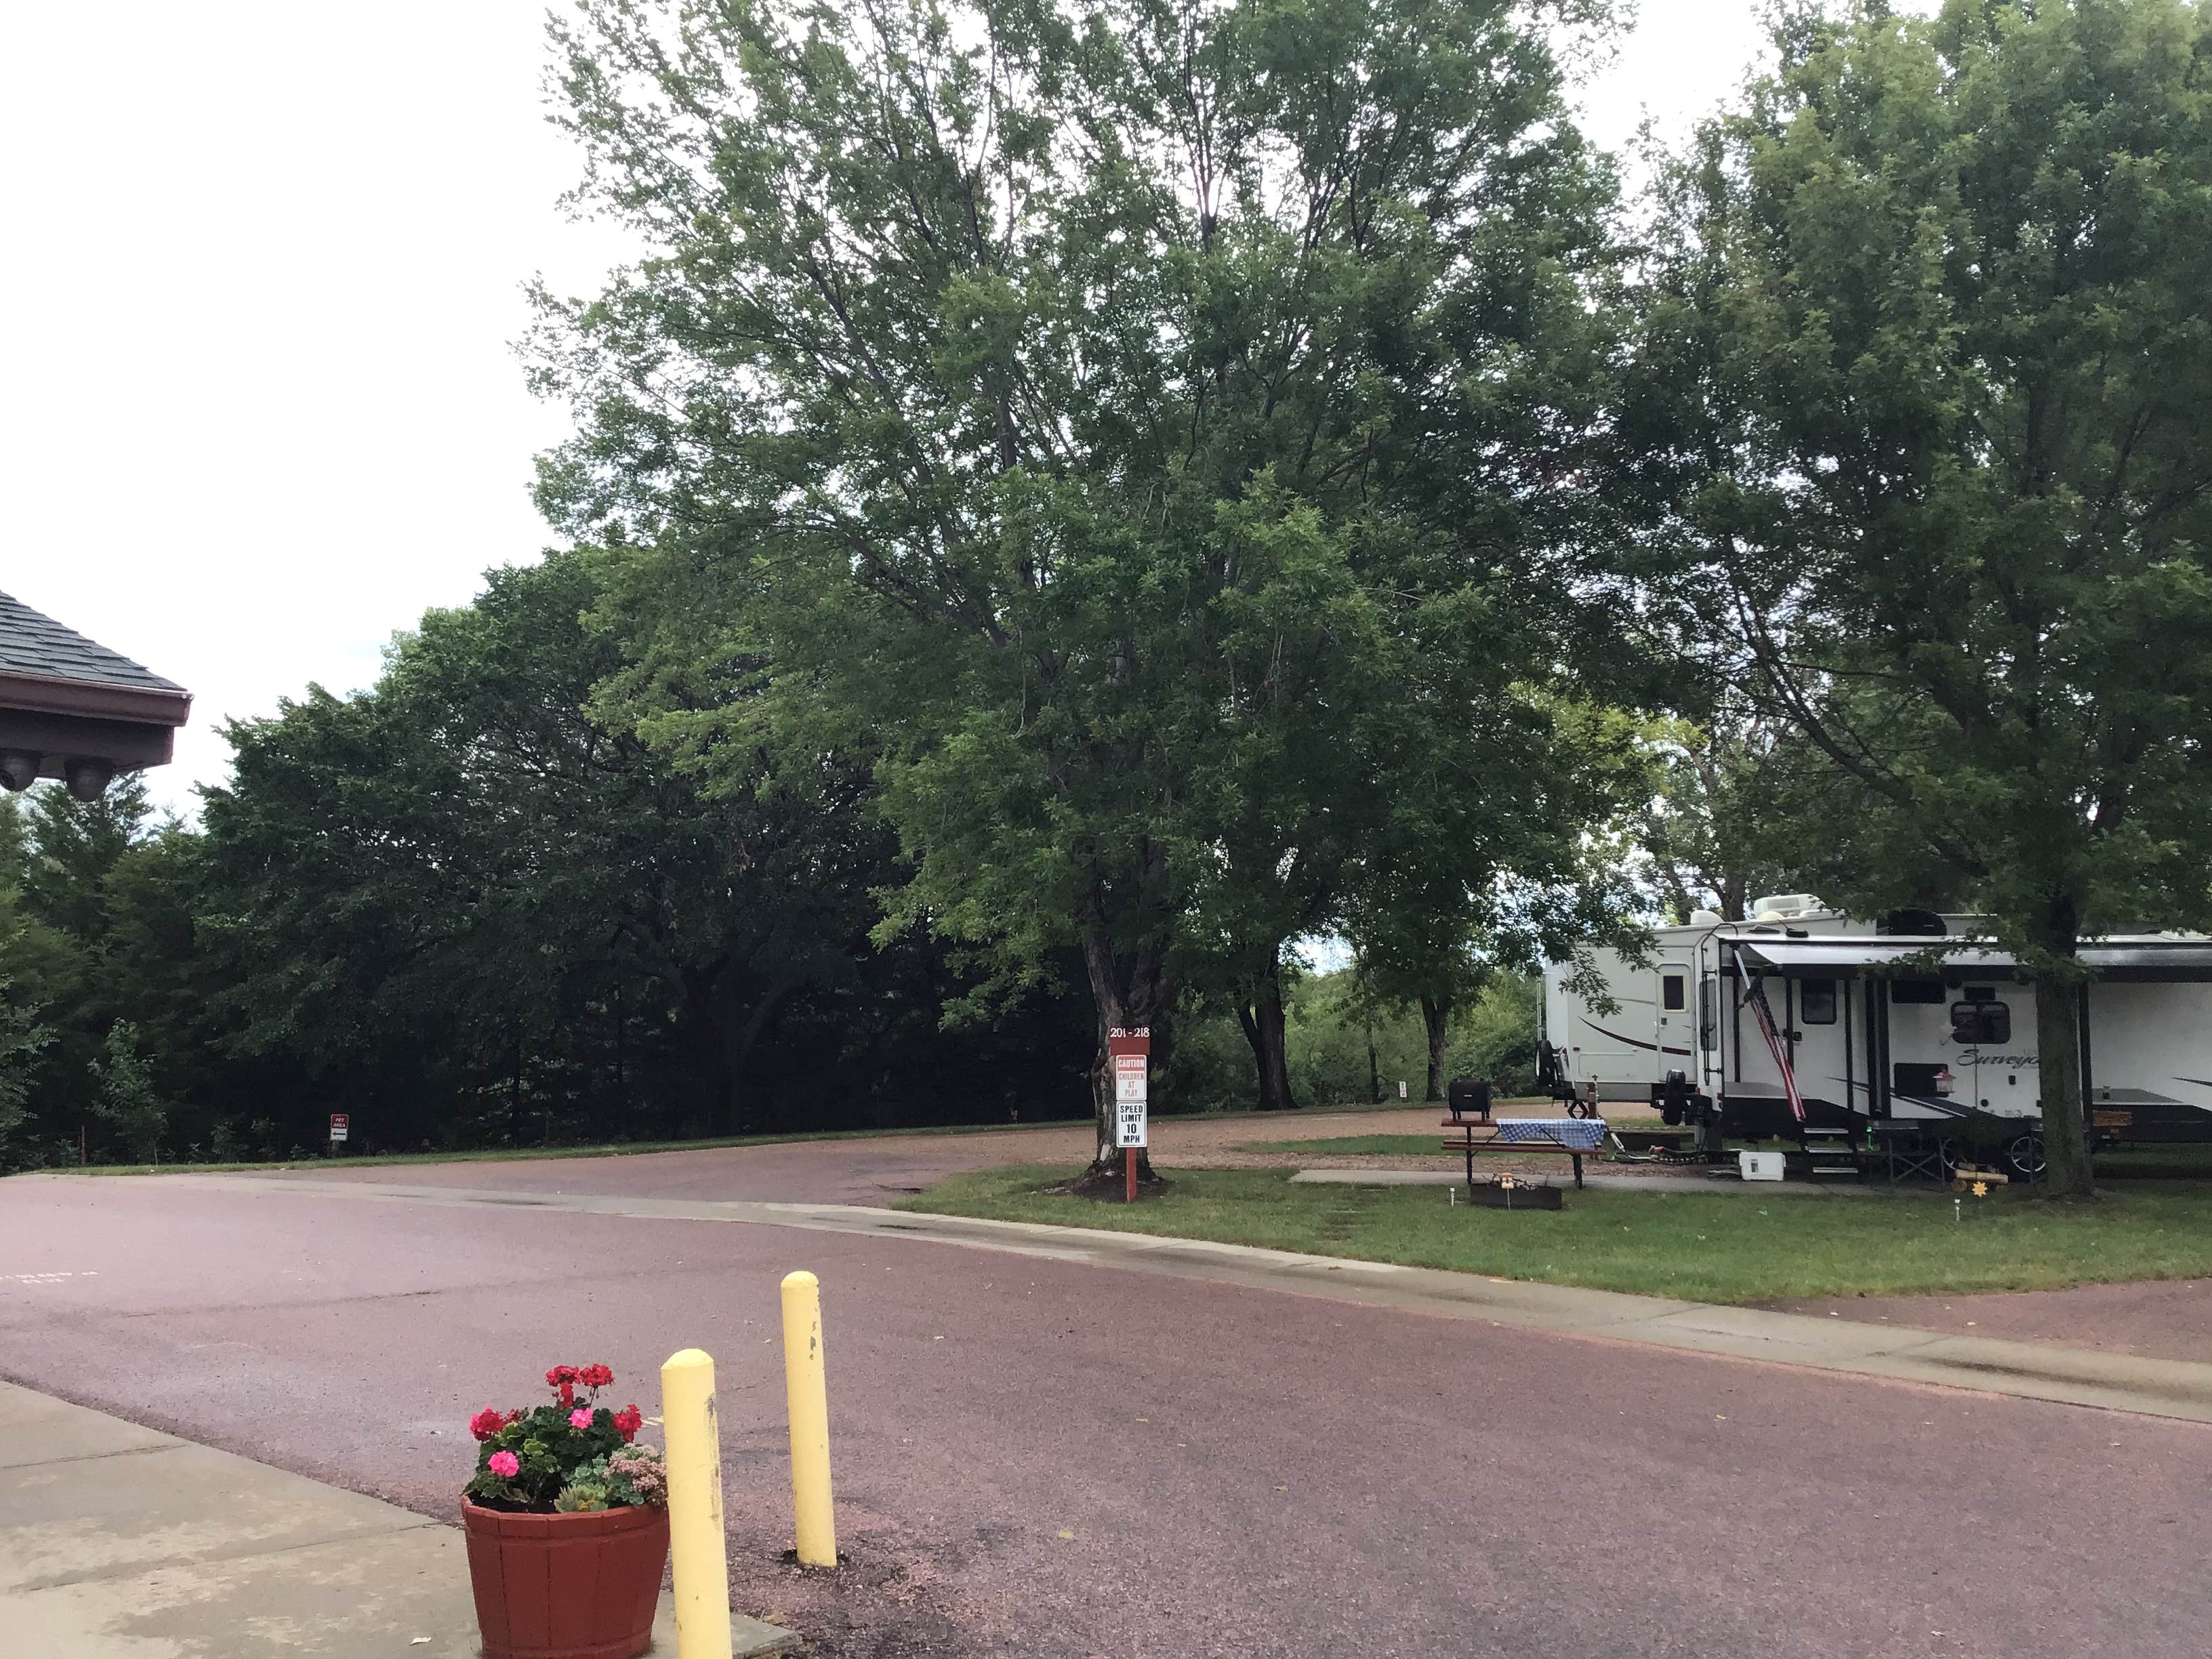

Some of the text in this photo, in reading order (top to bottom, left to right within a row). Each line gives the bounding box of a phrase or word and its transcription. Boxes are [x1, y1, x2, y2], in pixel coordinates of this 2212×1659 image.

[1110, 1027, 1126, 1038] 201
[1134, 1027, 1149, 1038] 218
[1118, 1059, 1144, 1067] CAUTION
[1956, 1048, 2039, 1069] Surveyo
[1126, 1124, 1136, 1133] 10
